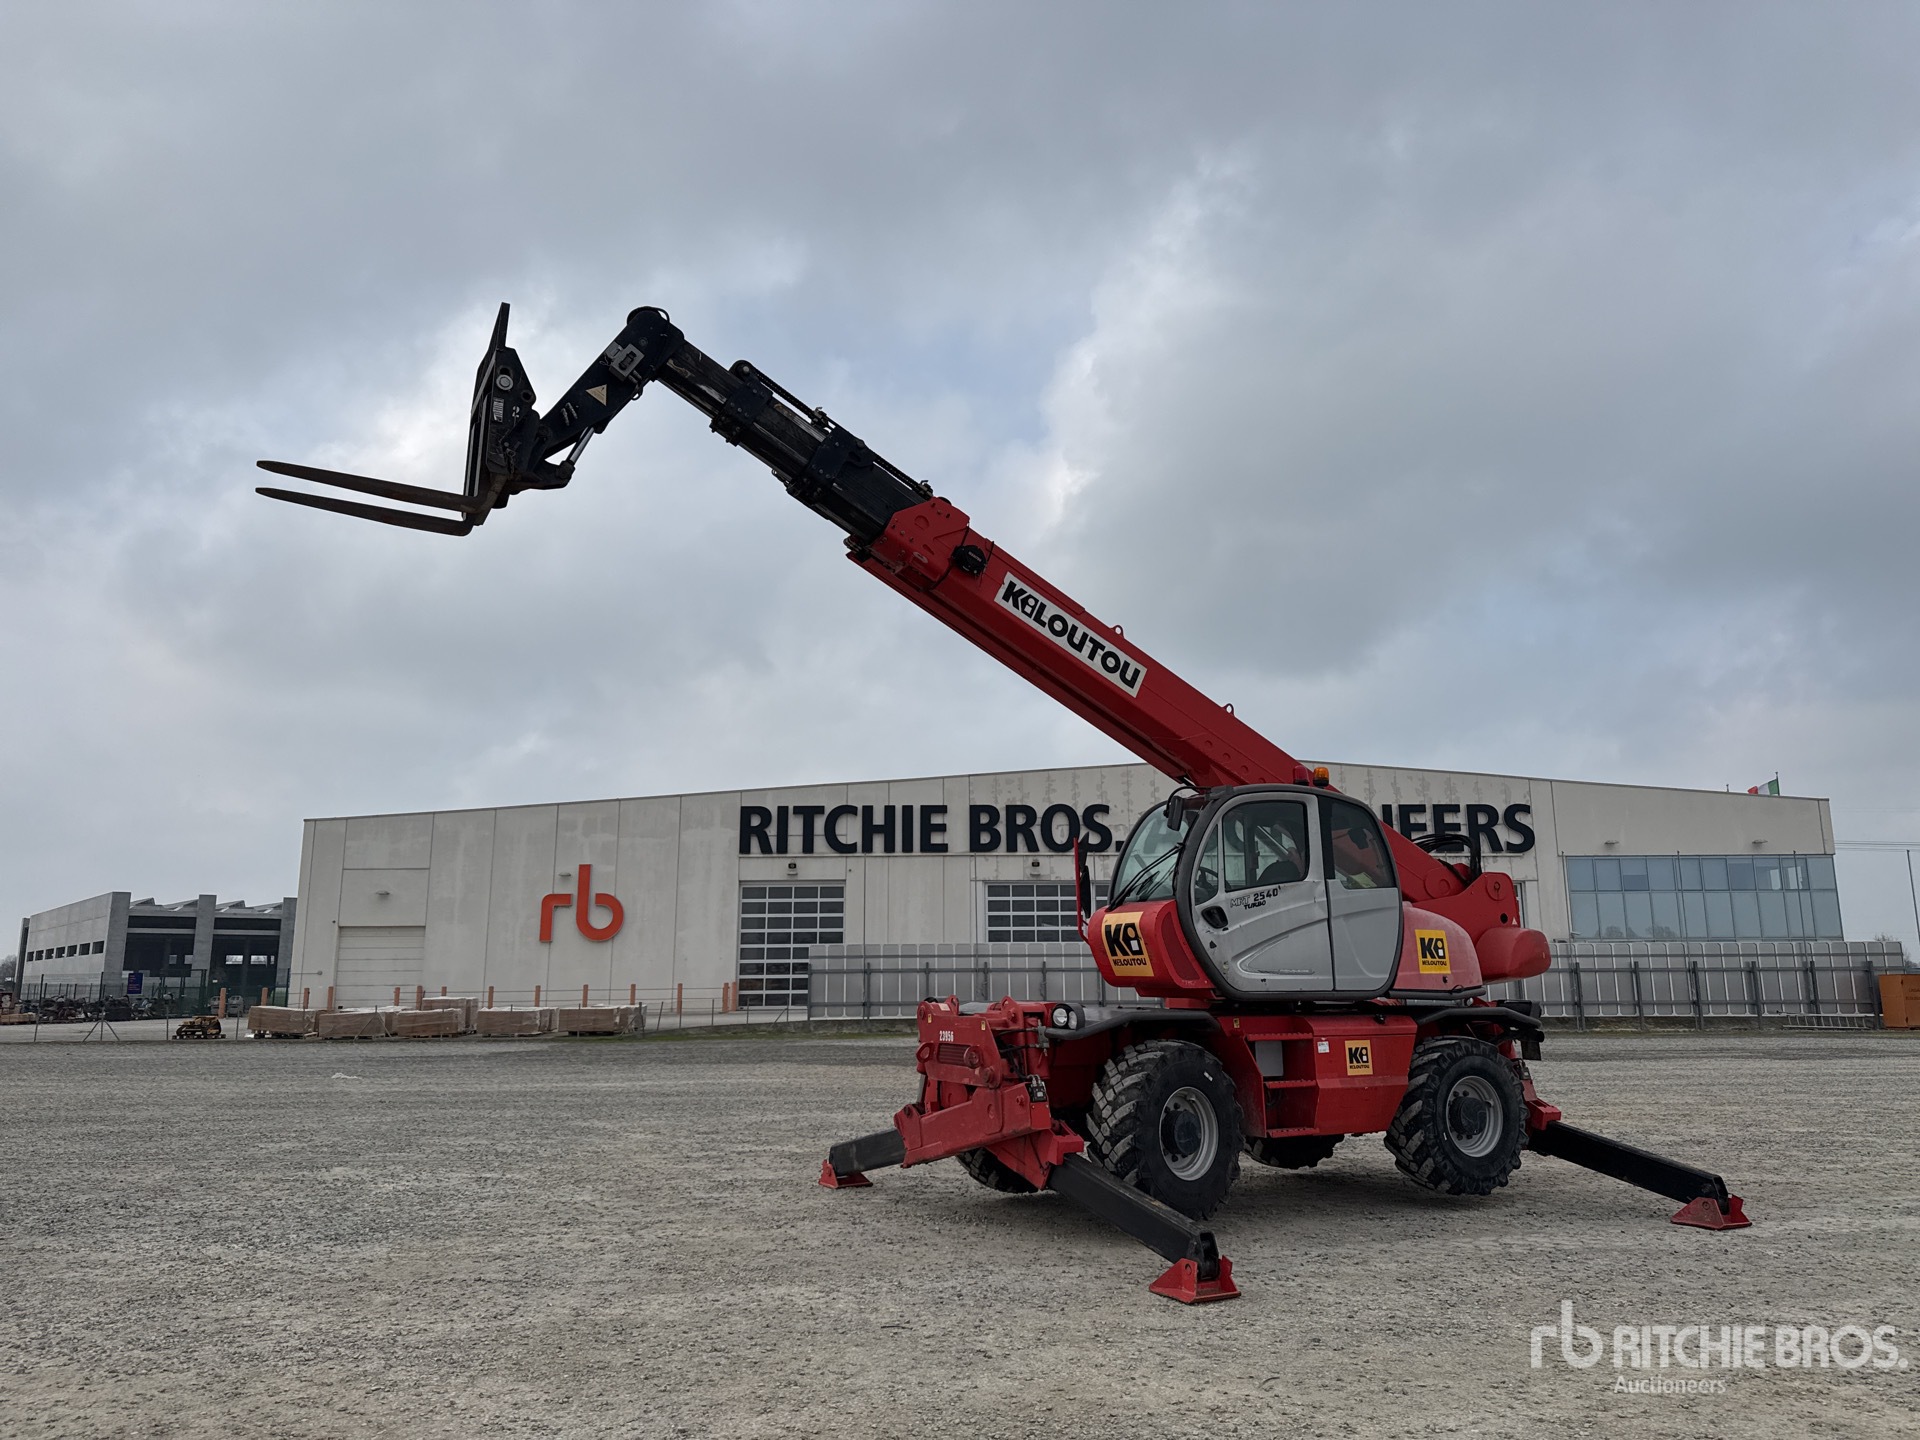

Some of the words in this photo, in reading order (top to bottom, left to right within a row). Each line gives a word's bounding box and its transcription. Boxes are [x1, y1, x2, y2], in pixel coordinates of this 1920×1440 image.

[740, 804, 948, 854] RITCHIE
[969, 803, 1124, 853] BROS.
[1253, 888, 1278, 902] 2540
[539, 864, 625, 943] rb
[1244, 900, 1267, 910] TURBO
[939, 1030, 954, 1042] 23956
